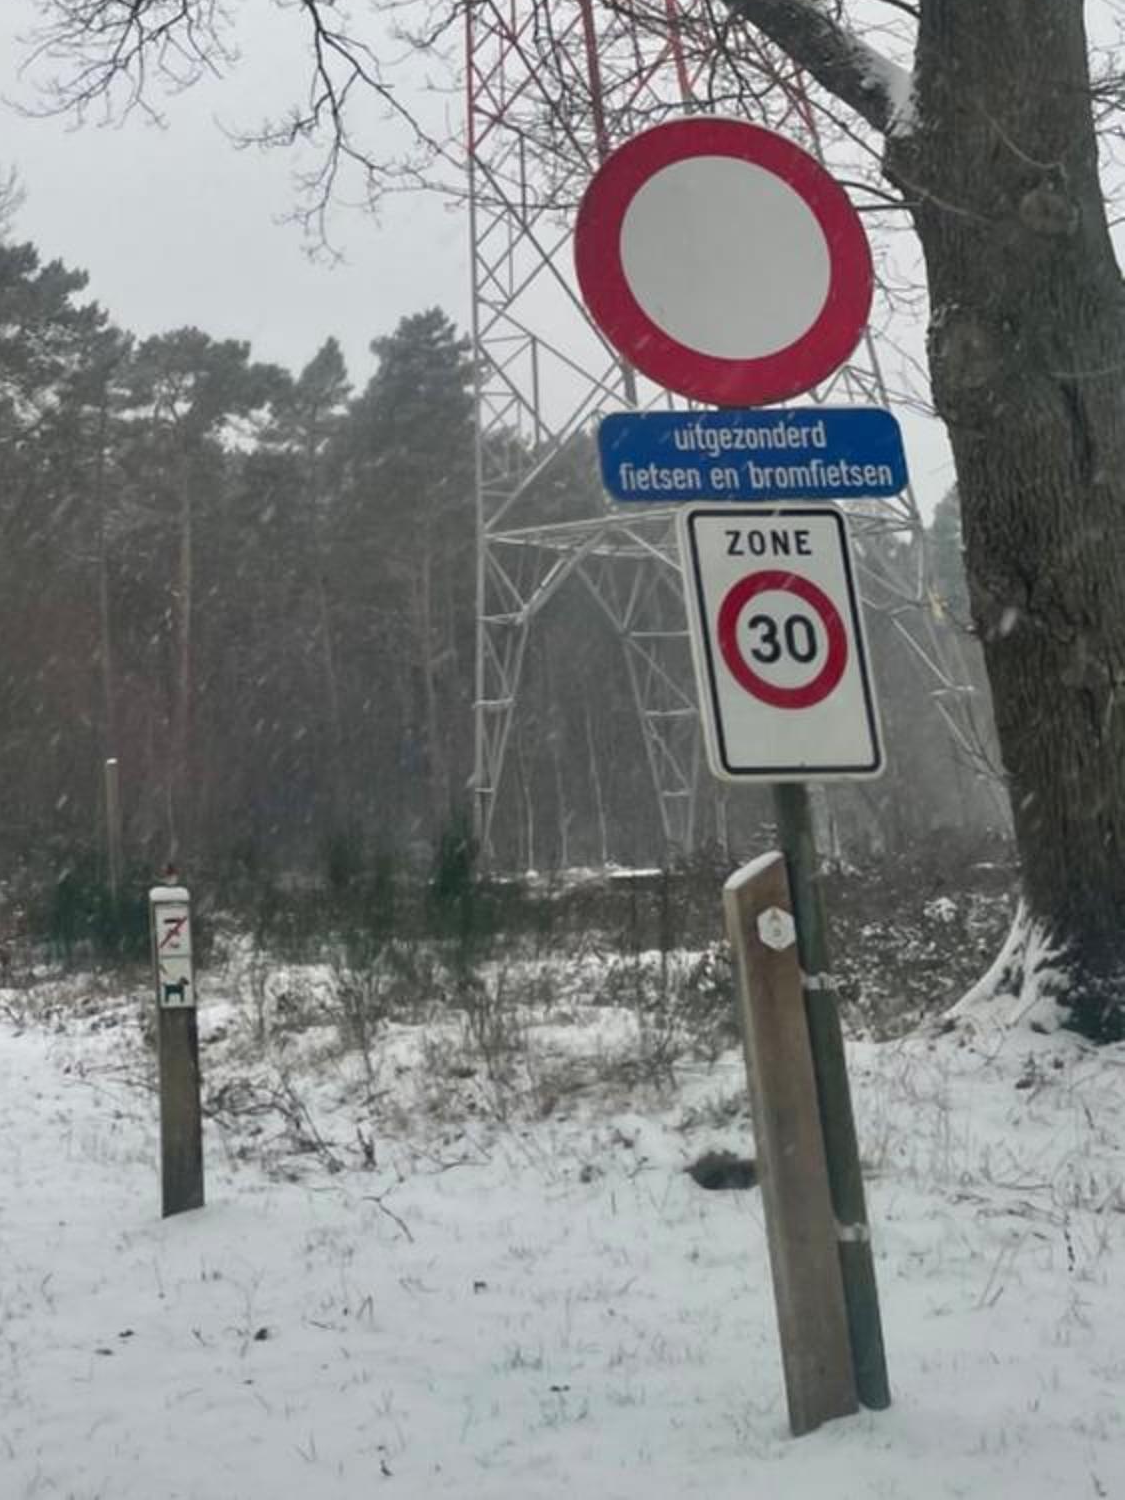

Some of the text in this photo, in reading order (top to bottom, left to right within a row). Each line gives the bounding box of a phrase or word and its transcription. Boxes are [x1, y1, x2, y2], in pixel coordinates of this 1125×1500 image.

[675, 421, 827, 457] uitgezonderd
[619, 460, 893, 491] fietsen en bromfietsen
[725, 530, 812, 556] ZONE
[747, 614, 818, 664] 30
